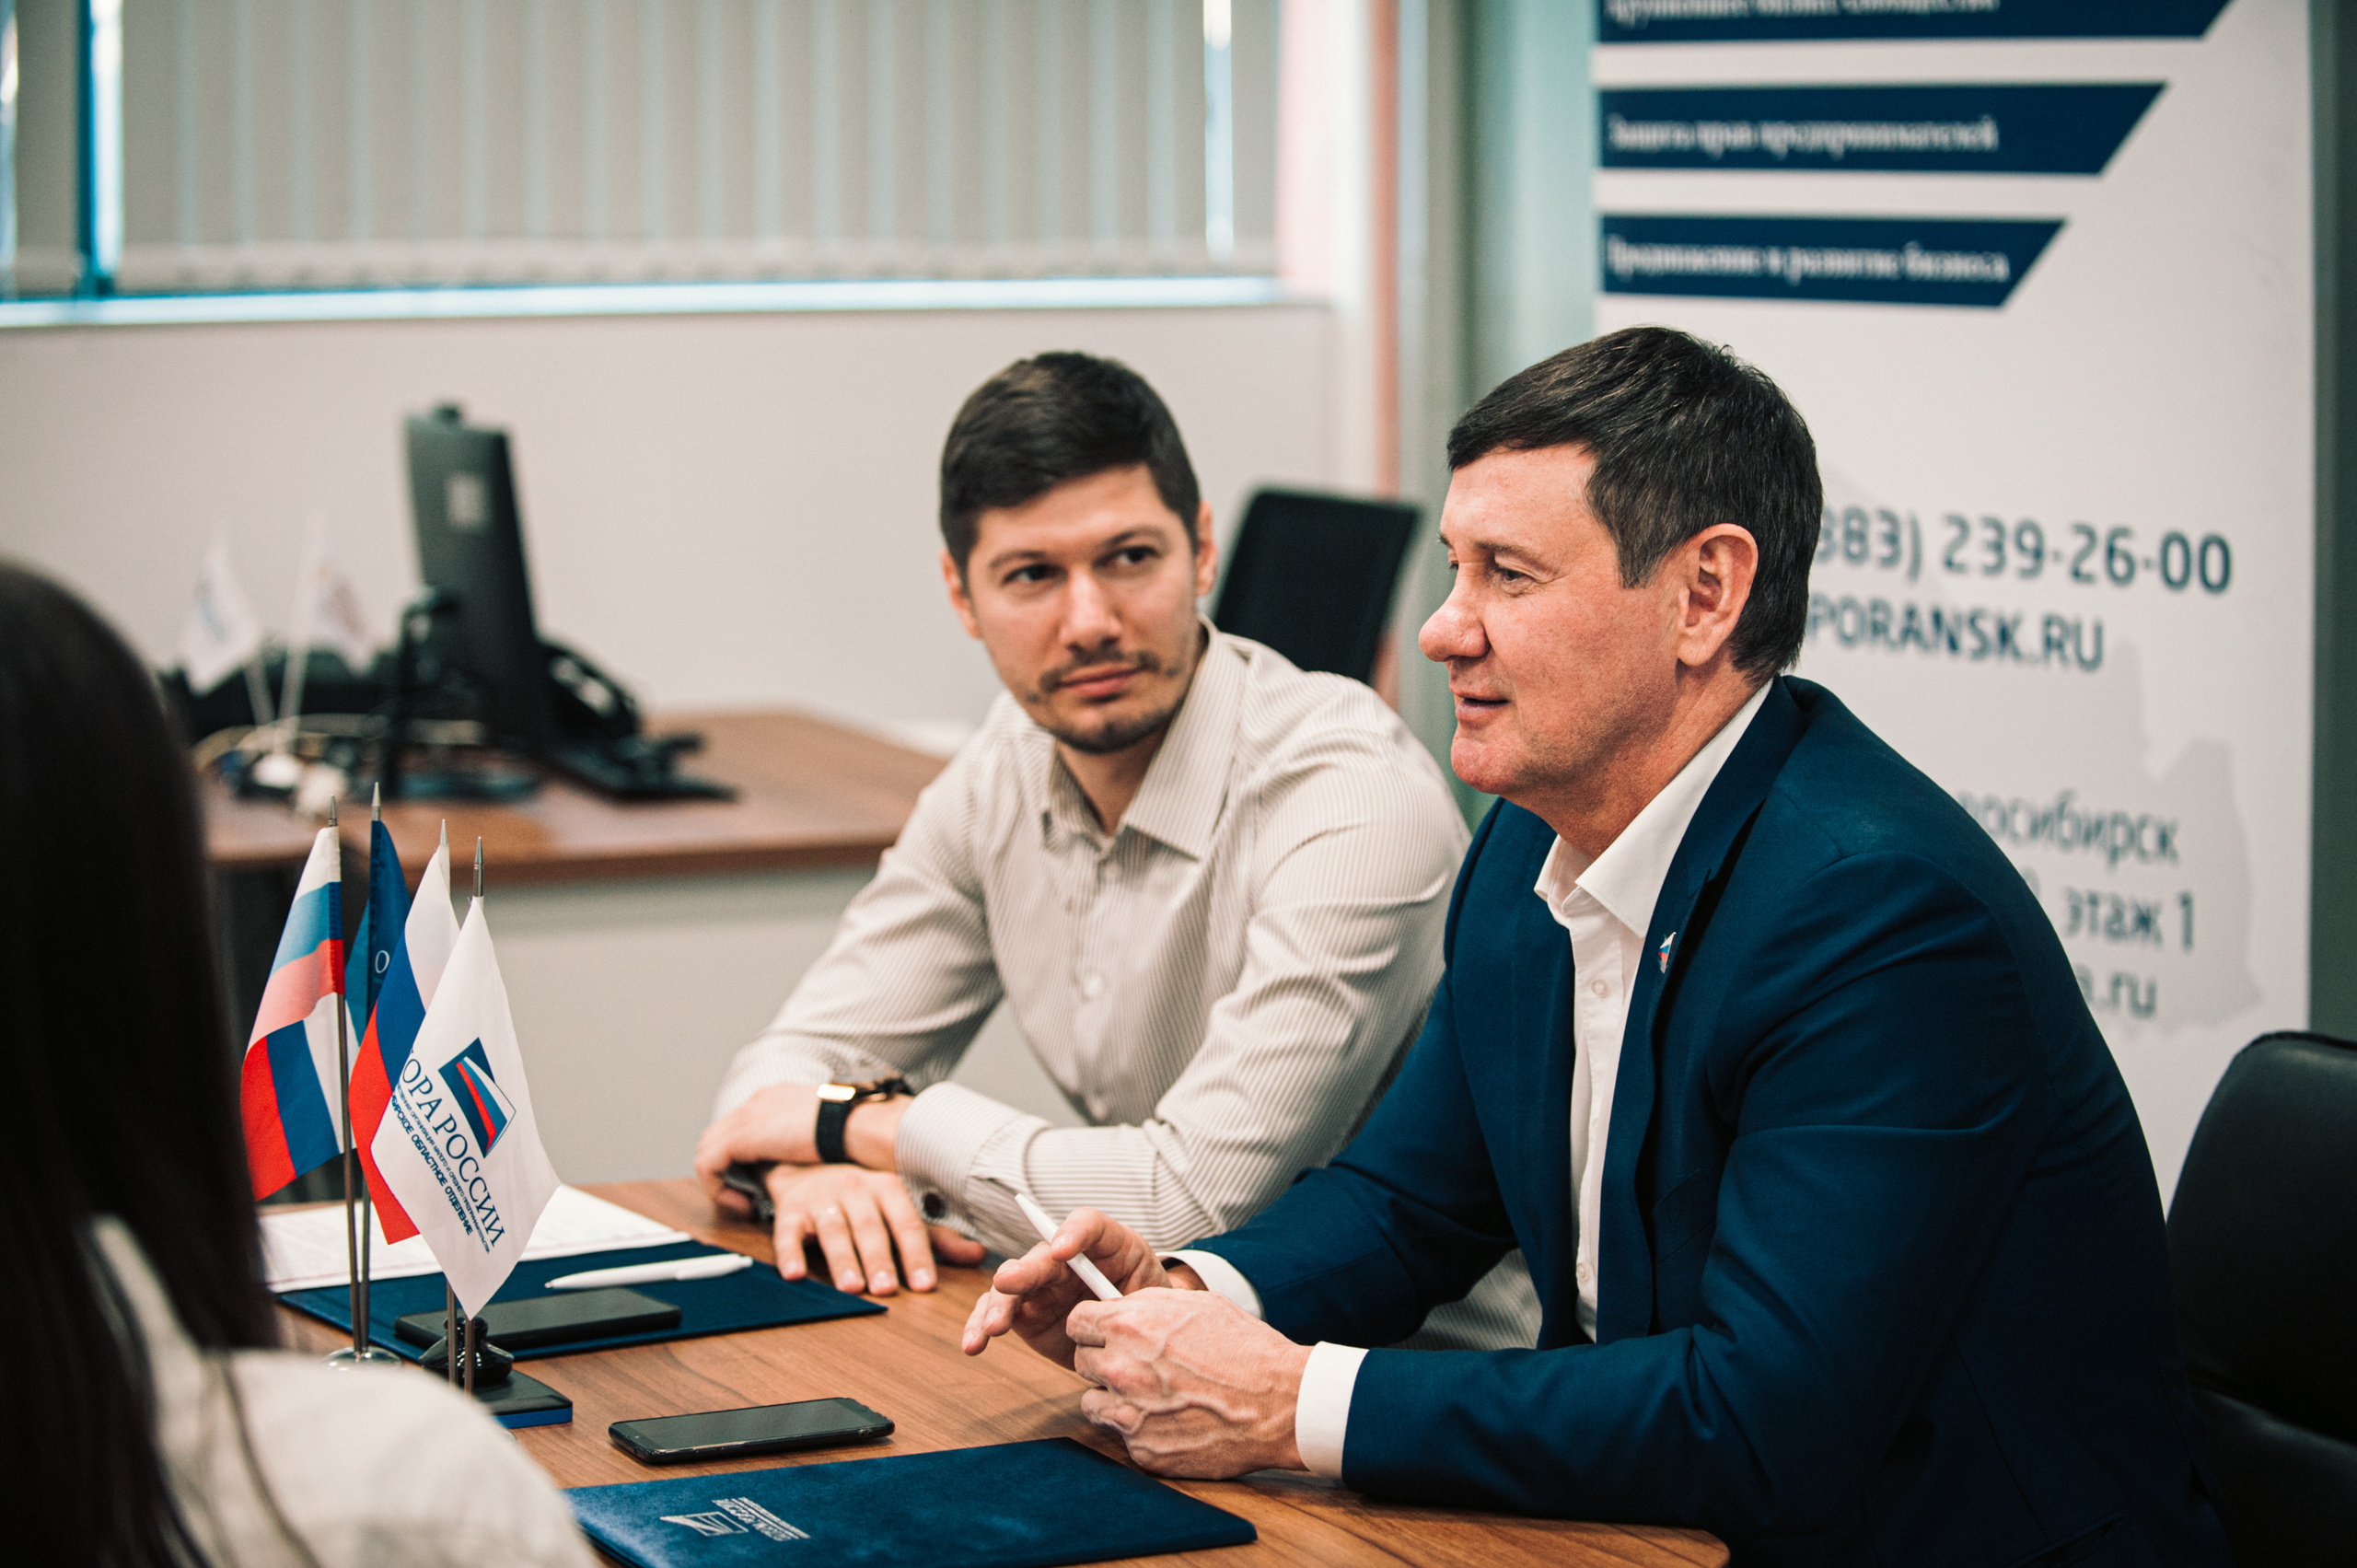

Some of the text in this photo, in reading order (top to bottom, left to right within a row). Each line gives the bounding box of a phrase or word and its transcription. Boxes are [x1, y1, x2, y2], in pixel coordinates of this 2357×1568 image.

[1942, 513, 2232, 594] 239-26-00
[2066, 887, 2194, 952] этаж 1
[402, 1048, 505, 1248] ОРА РОССИИ
[411, 1133, 448, 1187] ОБЛАСТНОЕ
[445, 1185, 474, 1237] ОТДЕЛЕНИЕ
